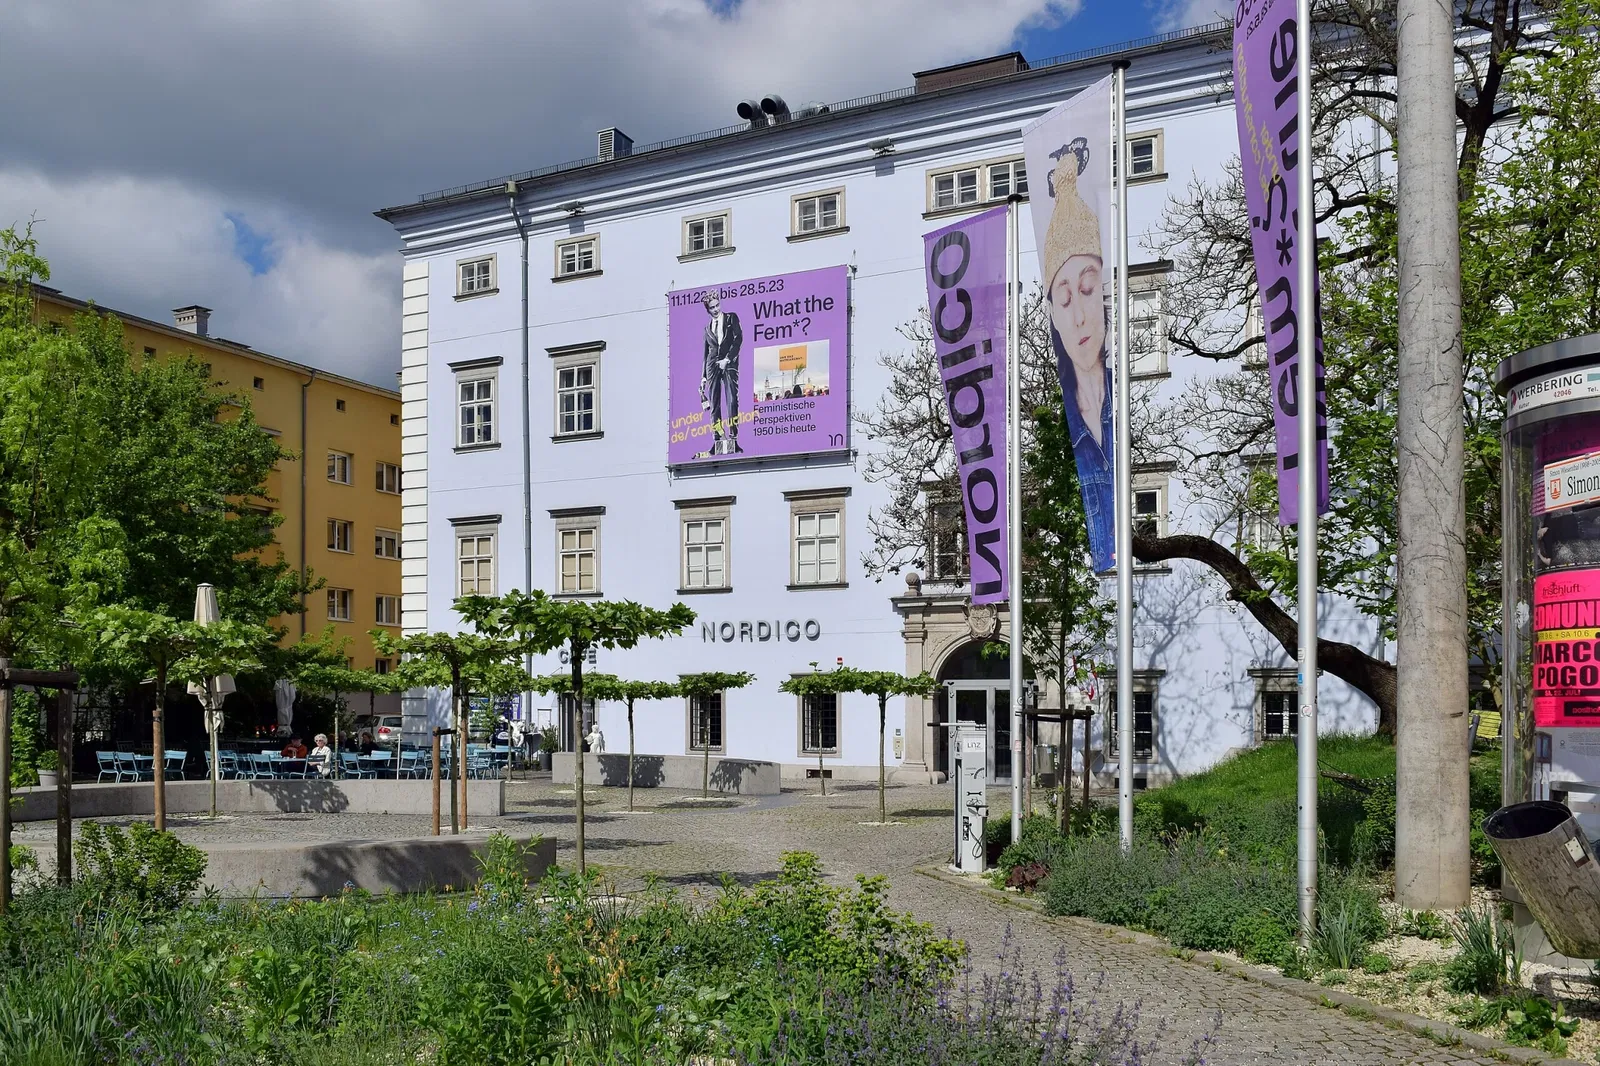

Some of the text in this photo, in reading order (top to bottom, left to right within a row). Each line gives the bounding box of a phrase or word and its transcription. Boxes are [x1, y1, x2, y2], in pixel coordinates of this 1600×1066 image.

[719, 286, 738, 300] bis
[739, 278, 785, 297] 28.5.23
[753, 294, 834, 320] What the
[1518, 373, 1583, 400] WERBERING
[753, 400, 816, 414] Feministische
[671, 411, 704, 429] under
[753, 413, 812, 426] Perspektiven
[753, 423, 817, 437] 1950 bis heute
[1567, 474, 1600, 497] Simon
[700, 618, 821, 643] NORDICO
[1537, 665, 1598, 688] POGO
